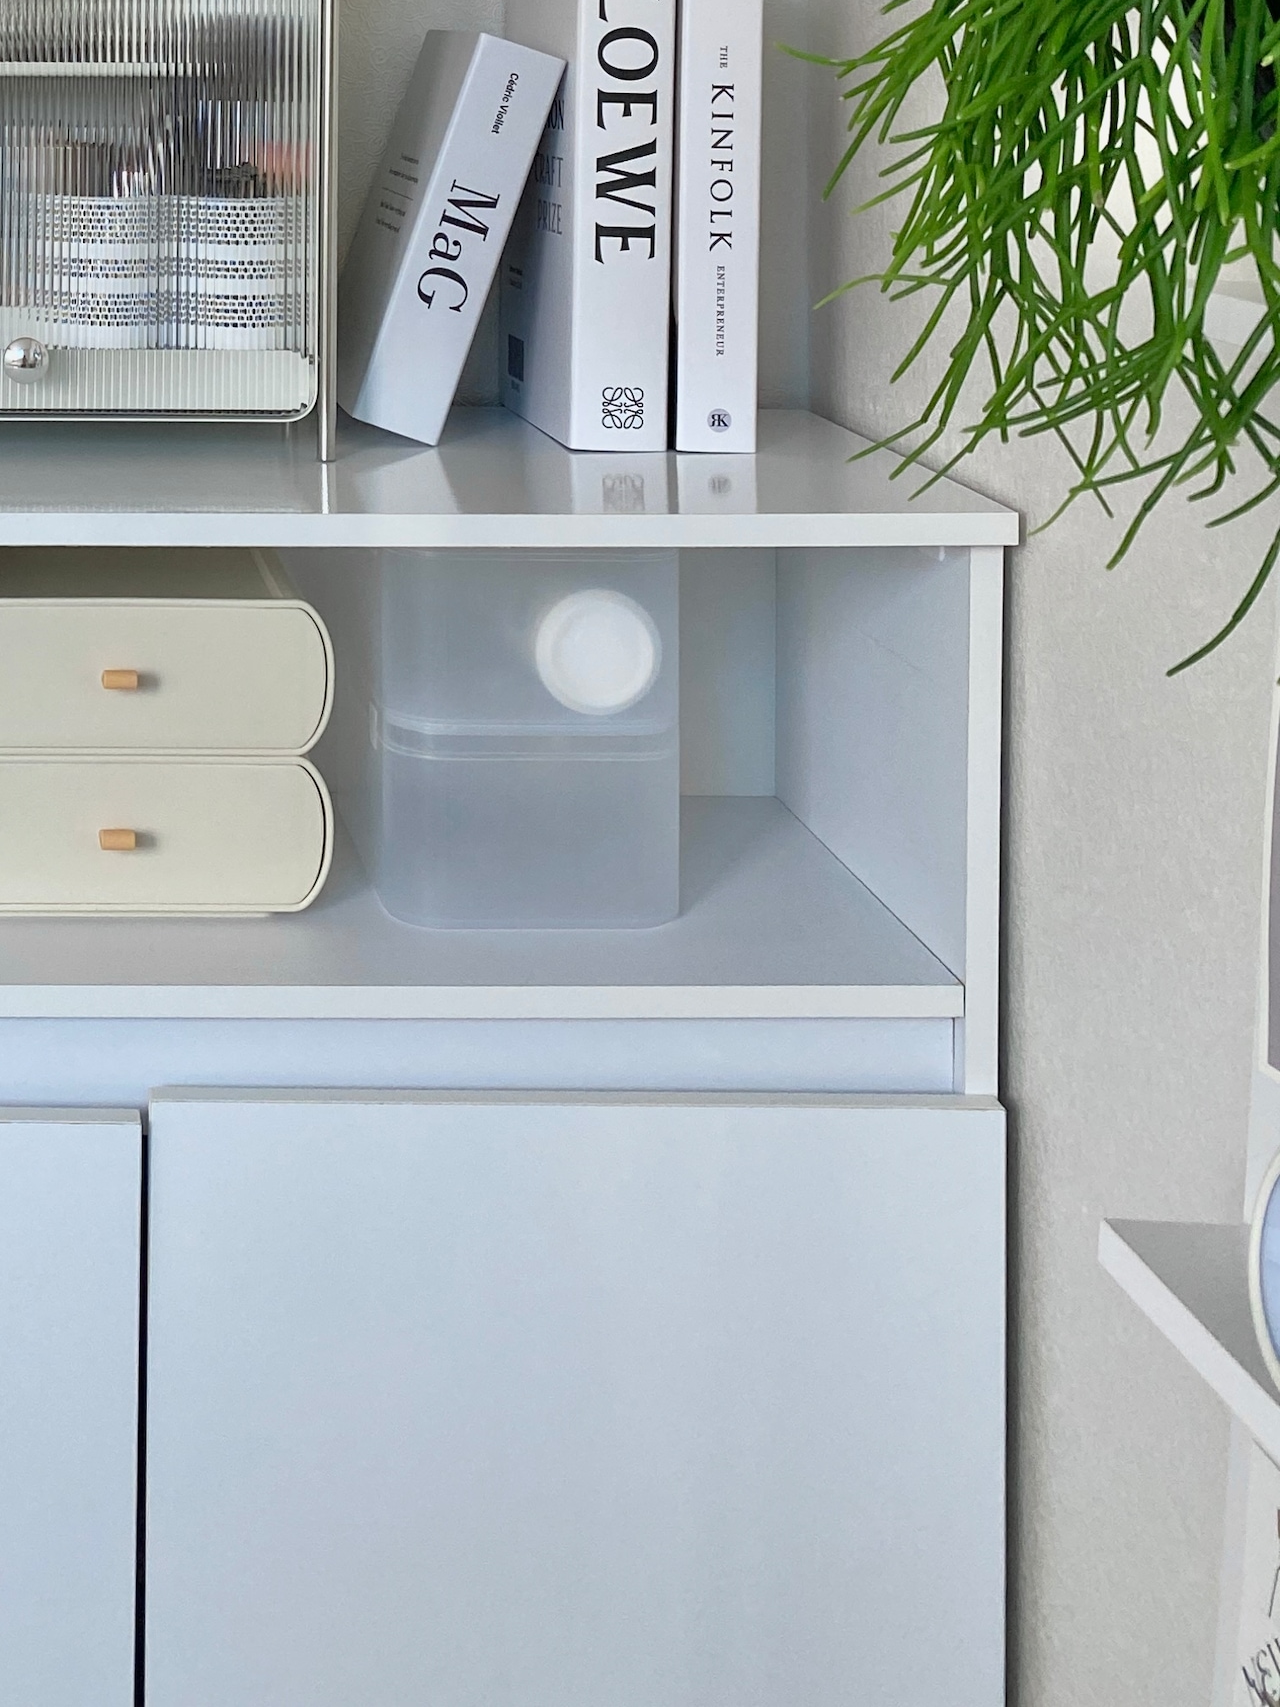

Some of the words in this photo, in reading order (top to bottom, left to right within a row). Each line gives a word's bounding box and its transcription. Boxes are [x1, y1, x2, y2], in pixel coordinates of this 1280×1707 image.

[719, 45, 729, 69] THE
[710, 84, 734, 251] KINFOLK
[716, 266, 725, 356] ENTREPRENEUR
